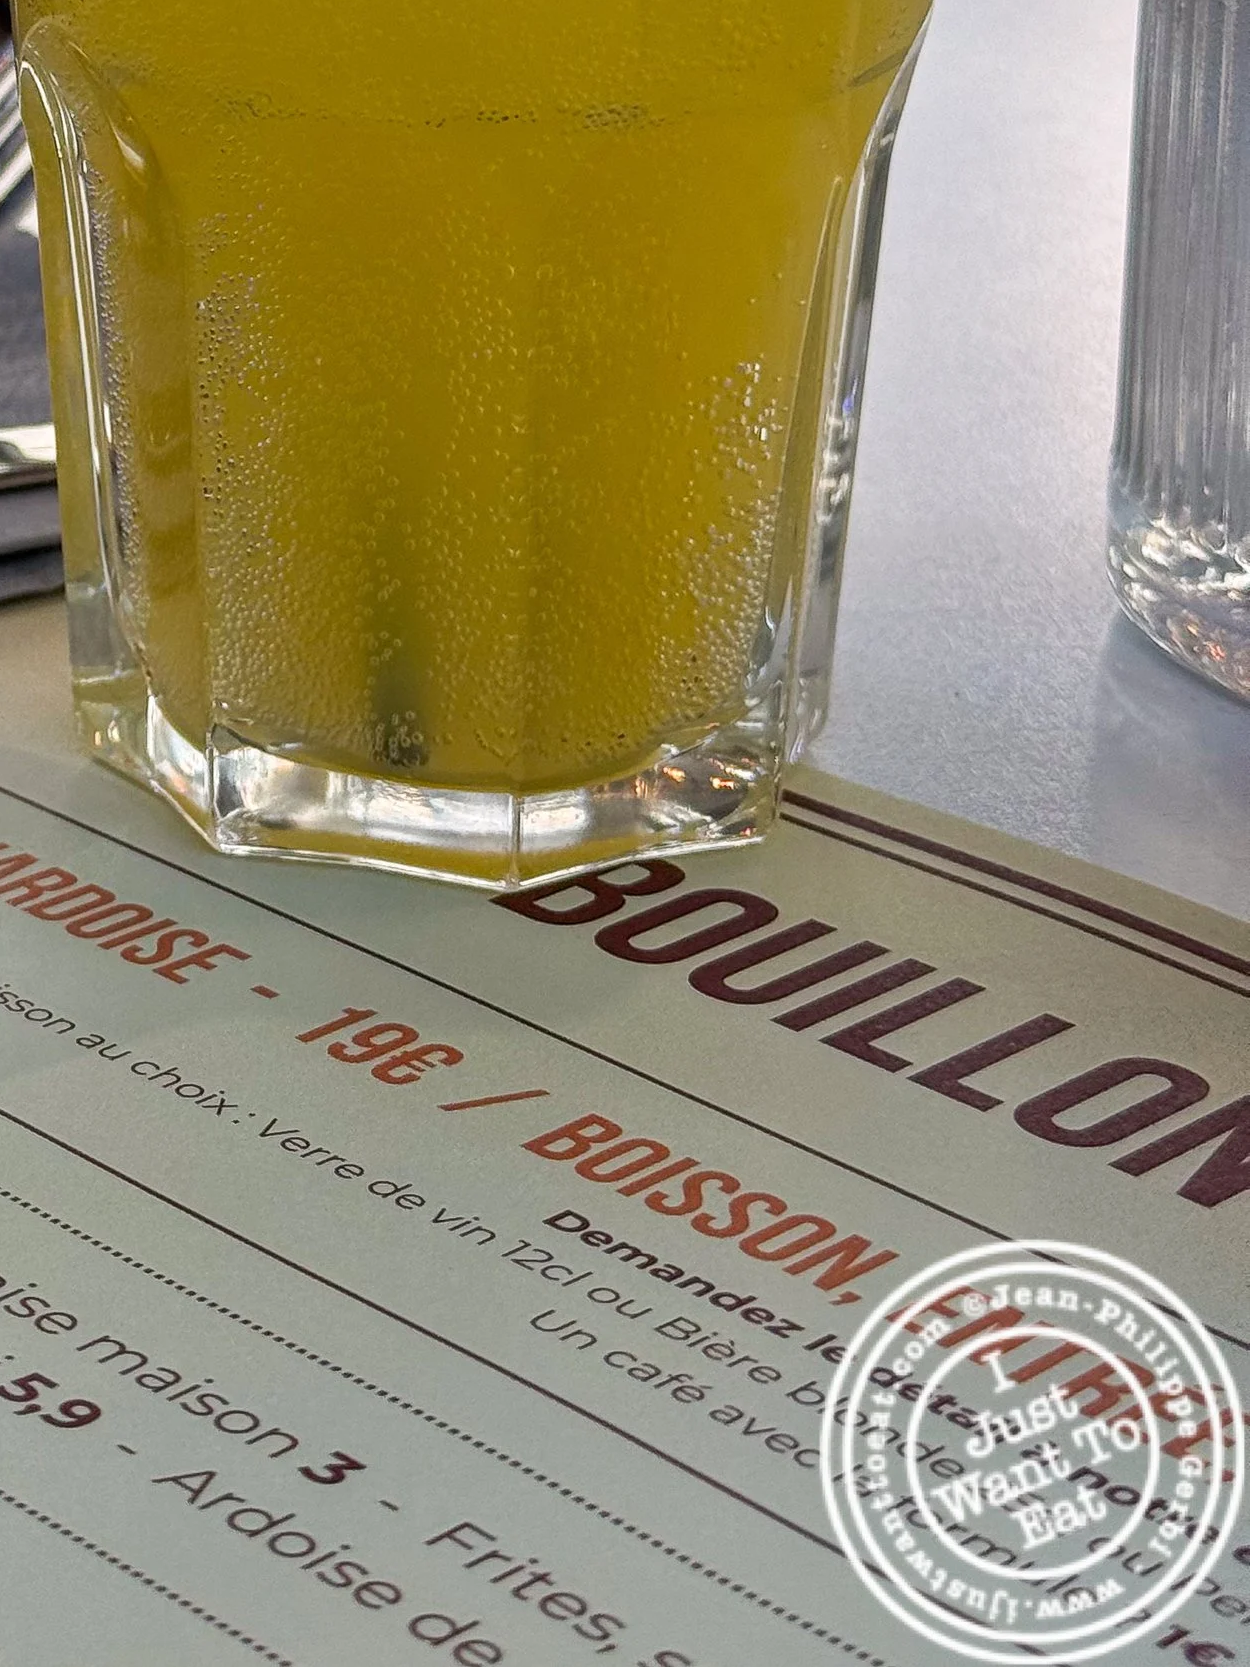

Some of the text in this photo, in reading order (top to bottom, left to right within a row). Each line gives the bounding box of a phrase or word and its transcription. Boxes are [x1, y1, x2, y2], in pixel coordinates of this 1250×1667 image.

[295, 1005, 464, 1086] 19€
[437, 1087, 551, 1112] /
[521, 1113, 899, 1306] BOISSON,
[488, 859, 1250, 1208] BOUILLON
[77, 1028, 128, 1061] au
[130, 1050, 236, 1120] choix
[258, 1114, 364, 1182] Verre
[367, 1175, 426, 1209] de
[432, 1206, 498, 1246] vin
[502, 1239, 593, 1287] 12cl
[587, 1286, 653, 1320] ou
[654, 1315, 783, 1385] Bière
[542, 1209, 805, 1339] Demandez
[76, 1333, 301, 1459] maison
[299, 1450, 369, 1488] 3
[425, 1521, 627, 1654] Frites,
[530, 1309, 598, 1351] Un
[603, 1350, 714, 1405] café
[709, 1404, 823, 1469] avec
[151, 1469, 402, 1610] Ardoise
[408, 1613, 502, 1667] de
